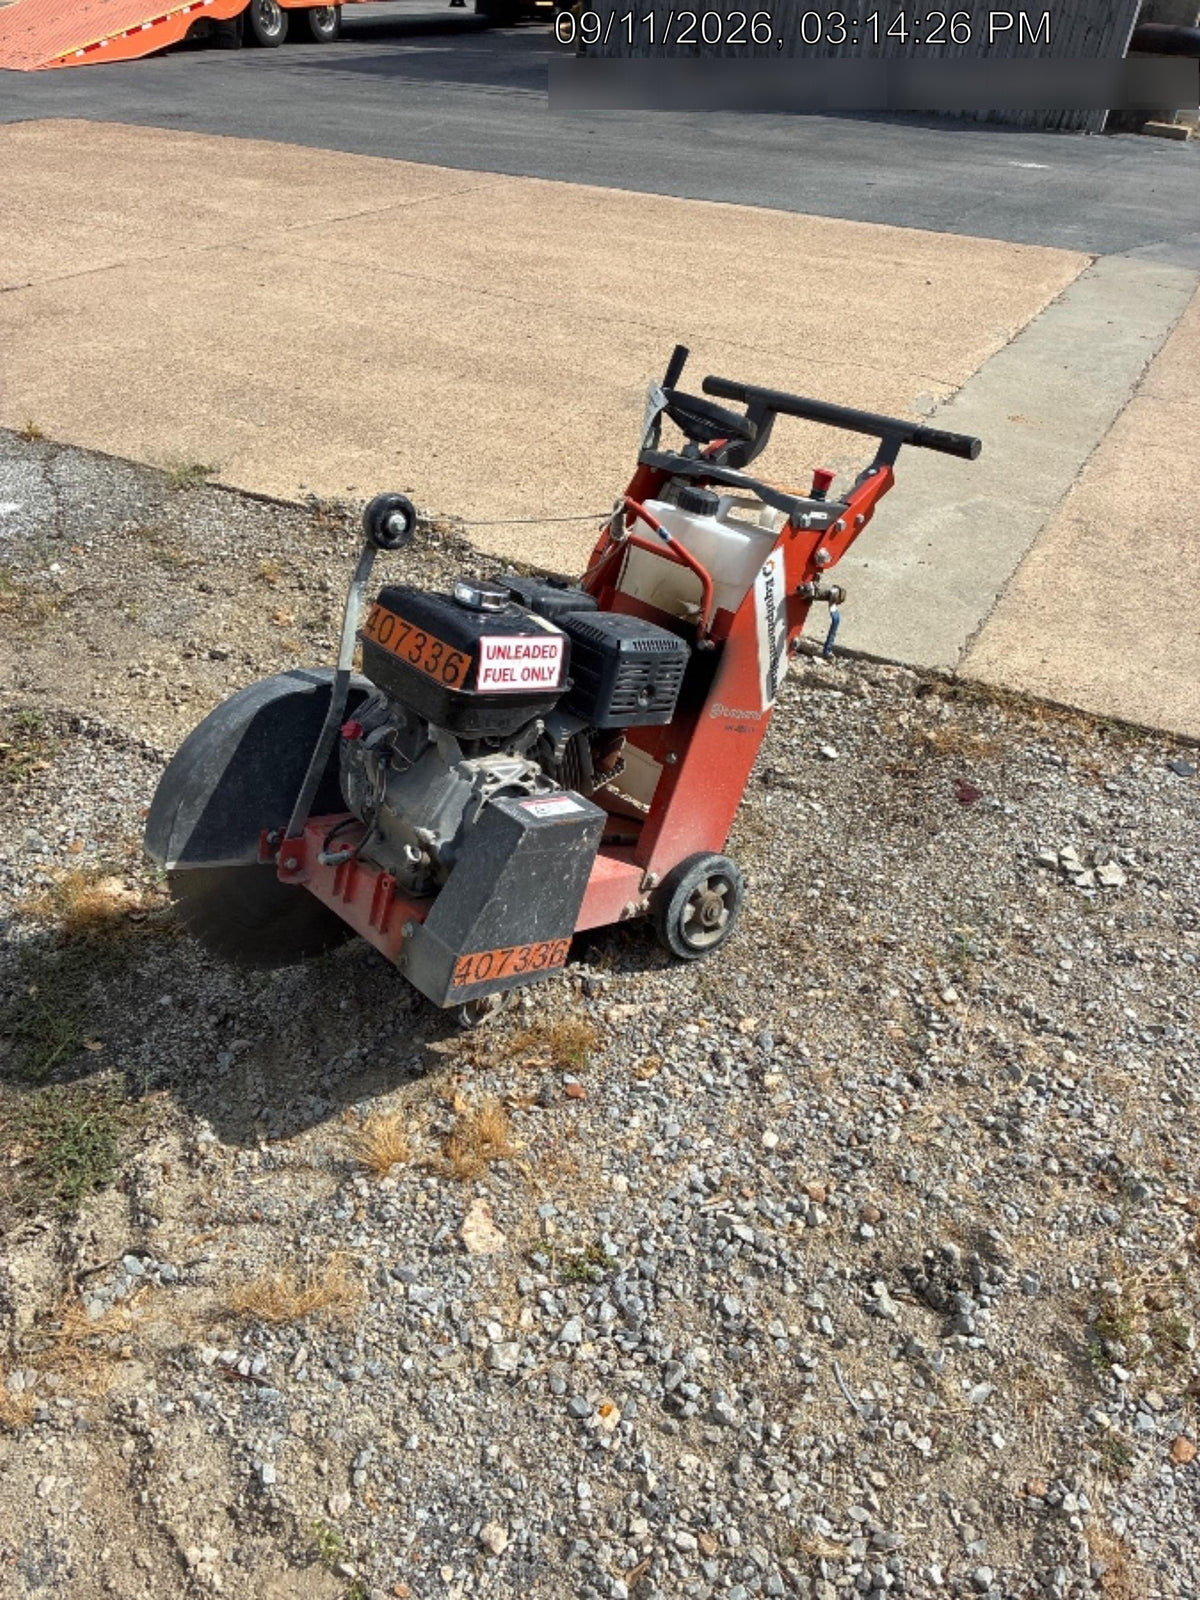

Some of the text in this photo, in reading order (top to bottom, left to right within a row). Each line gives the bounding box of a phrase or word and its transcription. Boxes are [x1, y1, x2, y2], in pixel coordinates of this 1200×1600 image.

[365, 607, 465, 684] 407336
[486, 644, 558, 660] UNLEADED
[483, 667, 555, 683] FUEL ONLY
[454, 940, 567, 984] 407336
